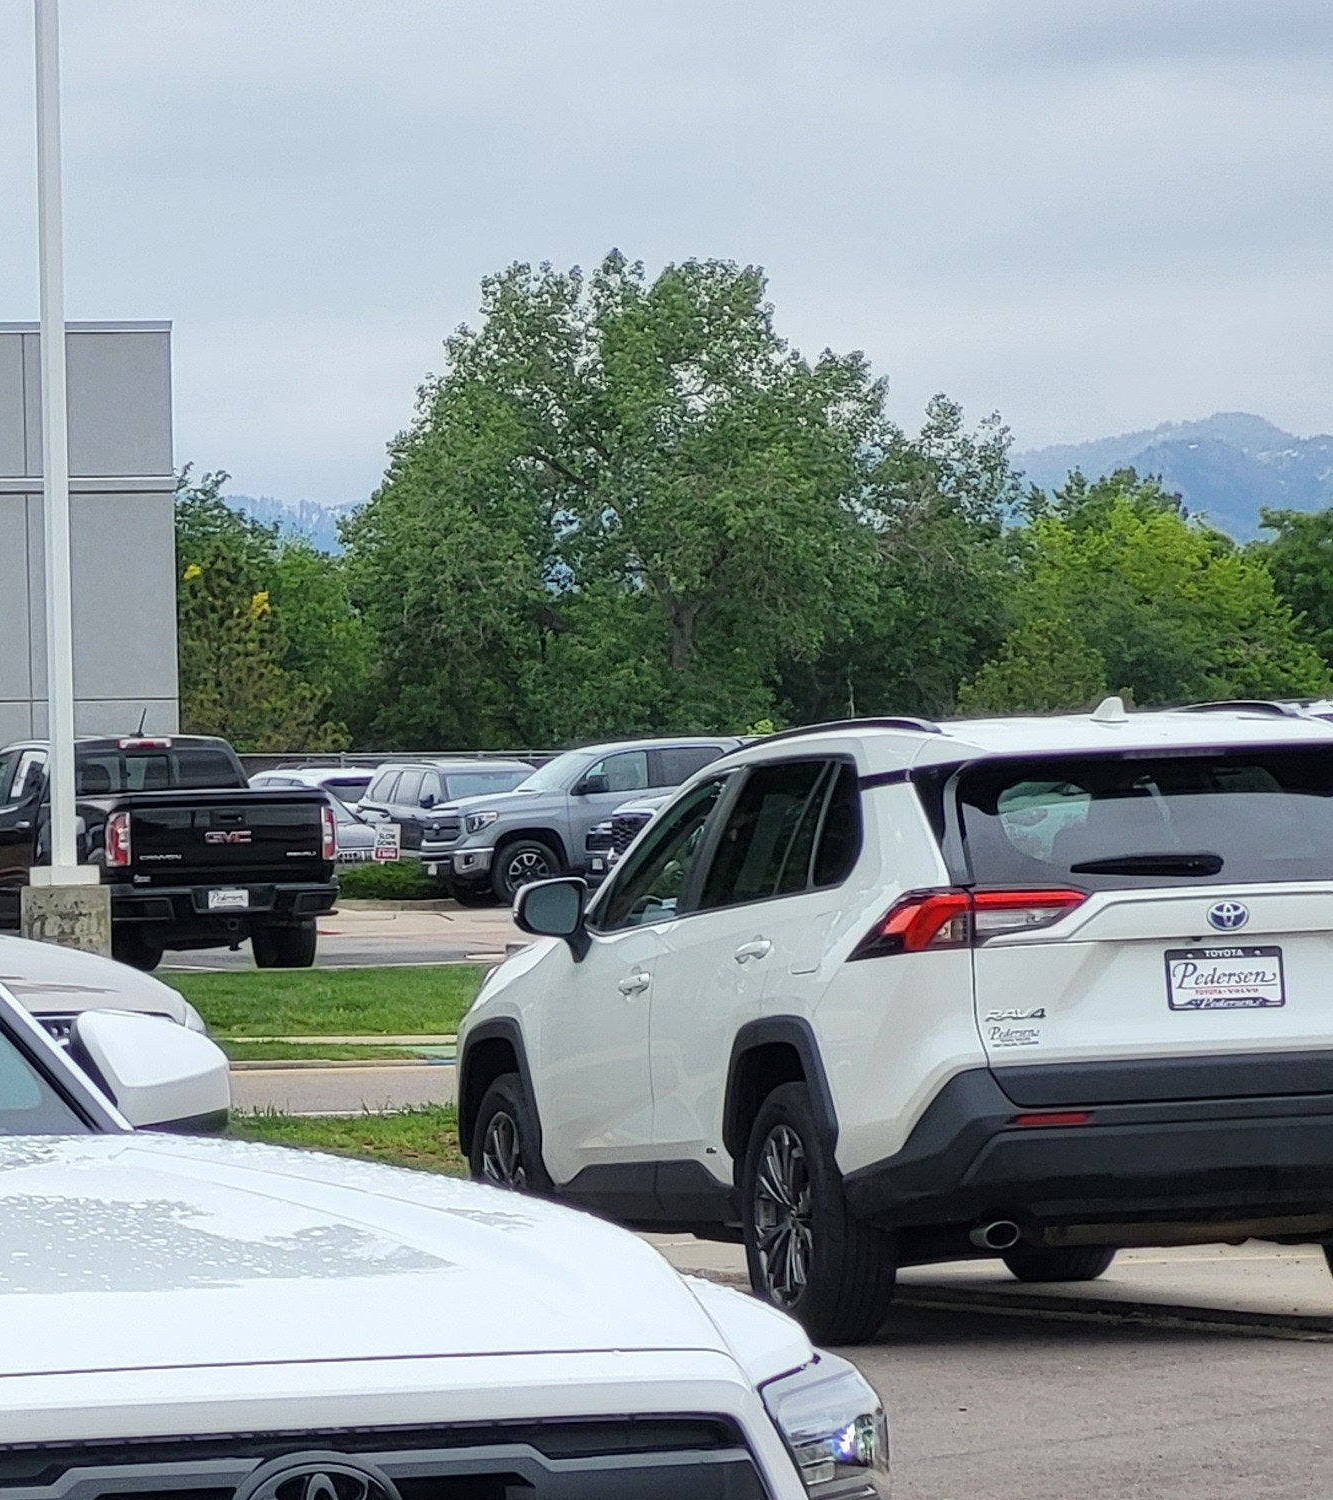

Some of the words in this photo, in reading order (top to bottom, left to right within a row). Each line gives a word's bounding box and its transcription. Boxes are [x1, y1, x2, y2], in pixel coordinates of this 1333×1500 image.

[204, 830, 252, 843] GMC
[1204, 949, 1244, 958] TOYOTA
[1173, 962, 1277, 989] Pedersen
[985, 1007, 1046, 1022] RAV4
